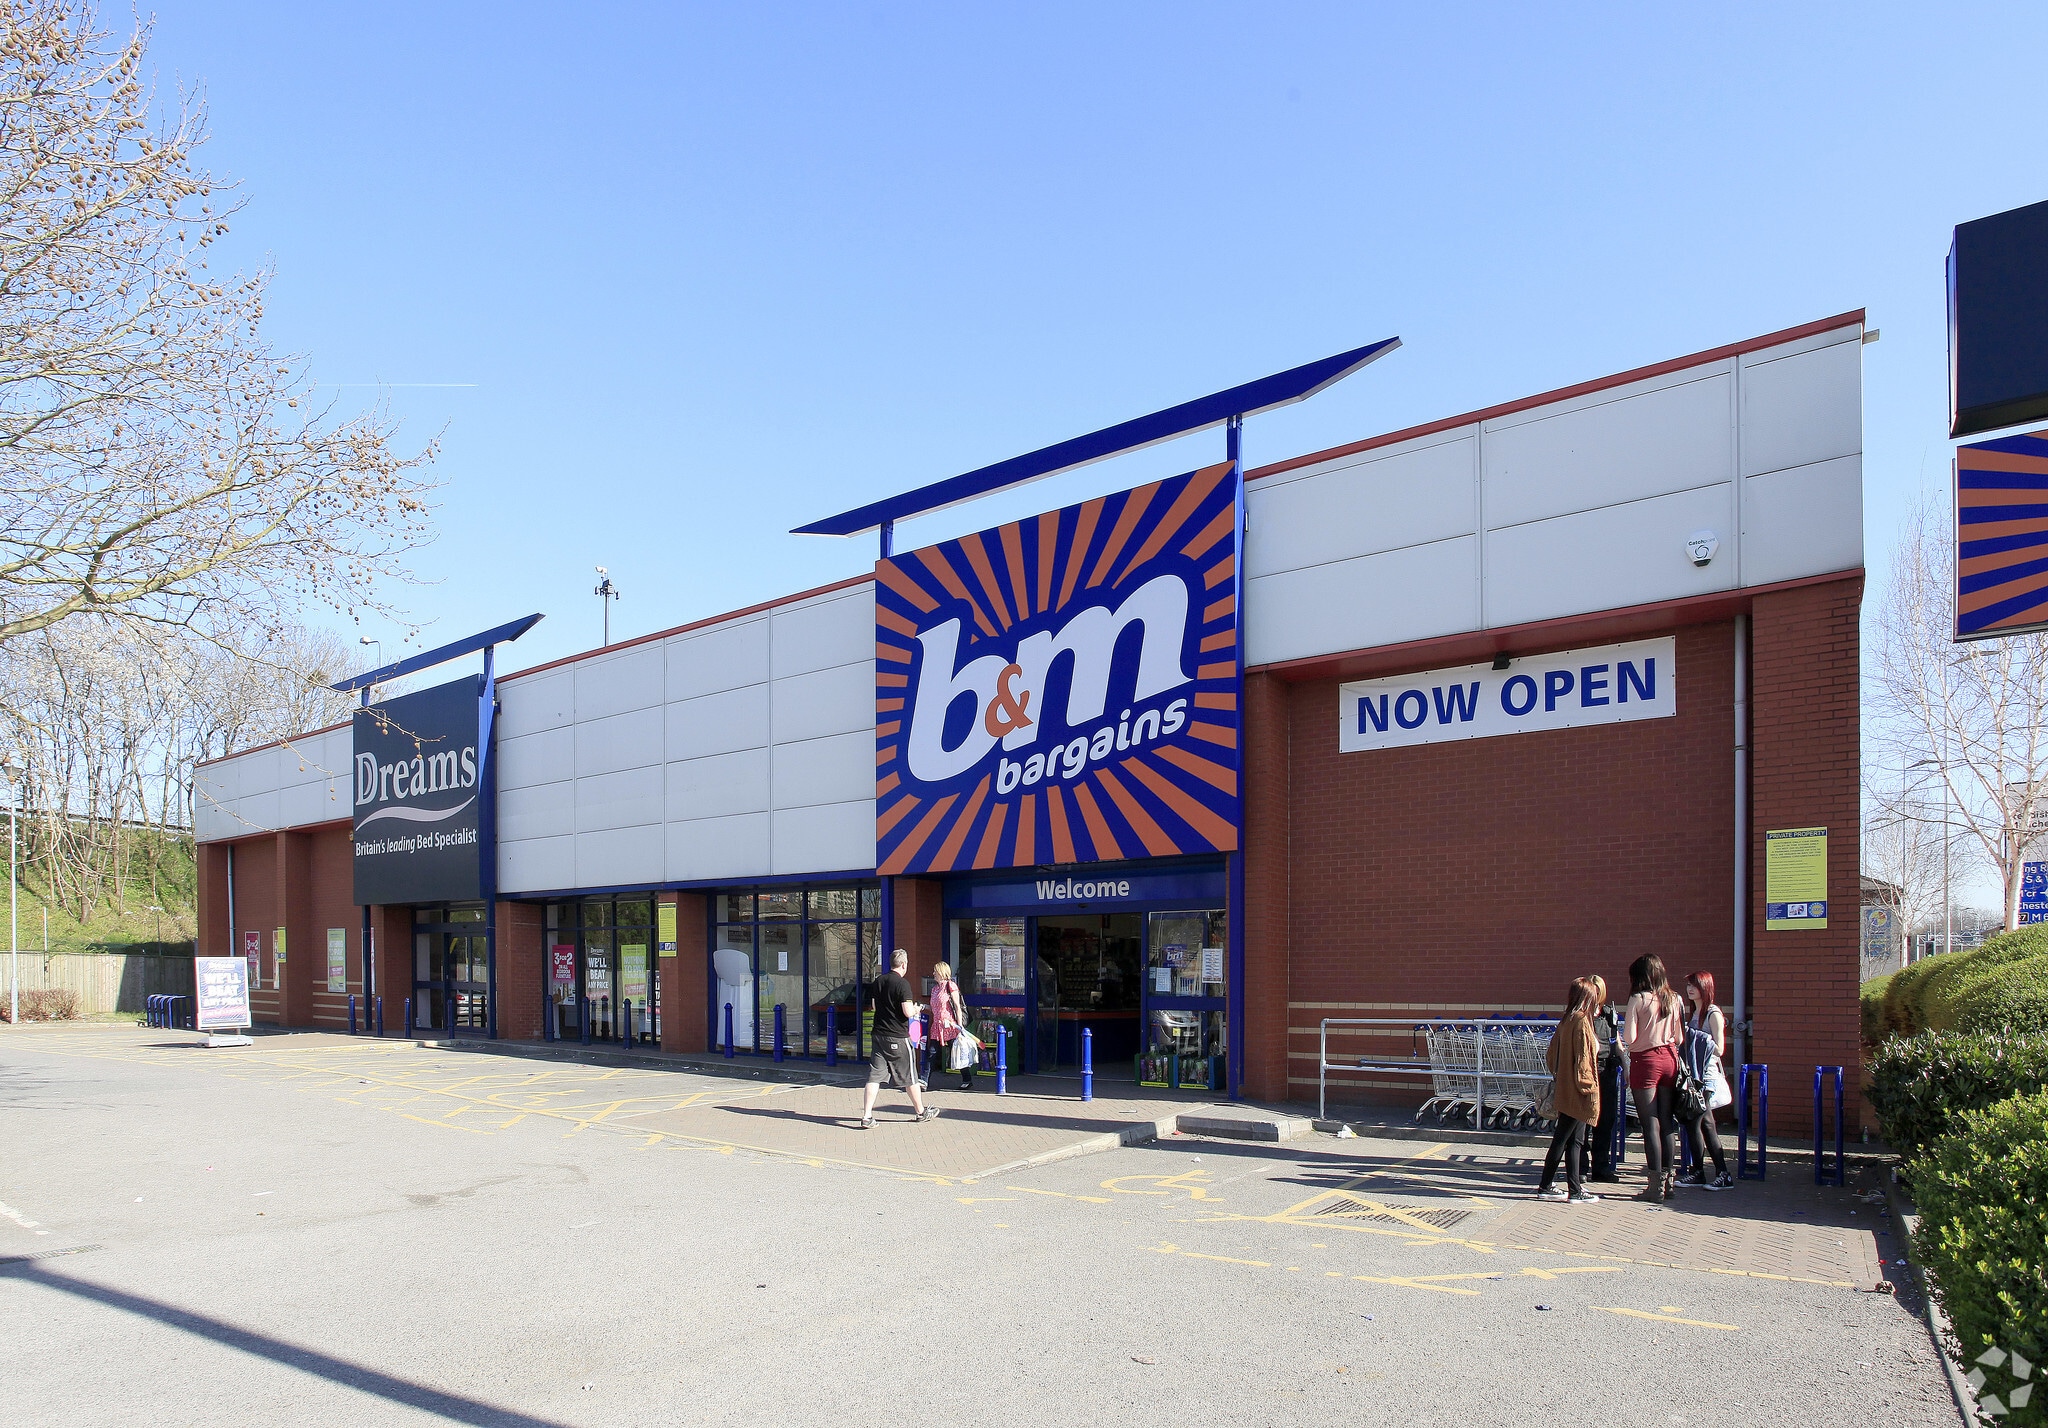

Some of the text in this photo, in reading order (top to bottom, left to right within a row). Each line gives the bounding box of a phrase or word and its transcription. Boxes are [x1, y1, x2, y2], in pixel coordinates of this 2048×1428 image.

[908, 574, 1195, 783] b&m
[1357, 657, 1656, 735] NOW OPEN
[996, 698, 1188, 795] bargains
[355, 746, 476, 806] Dreams
[355, 828, 477, 857] Britain's leading Bed Specialist
[1036, 877, 1130, 900] Welcome
[588, 957, 607, 968] WE'LL
[590, 969, 606, 980] BEAT
[588, 981, 609, 989] ANY PRICE
